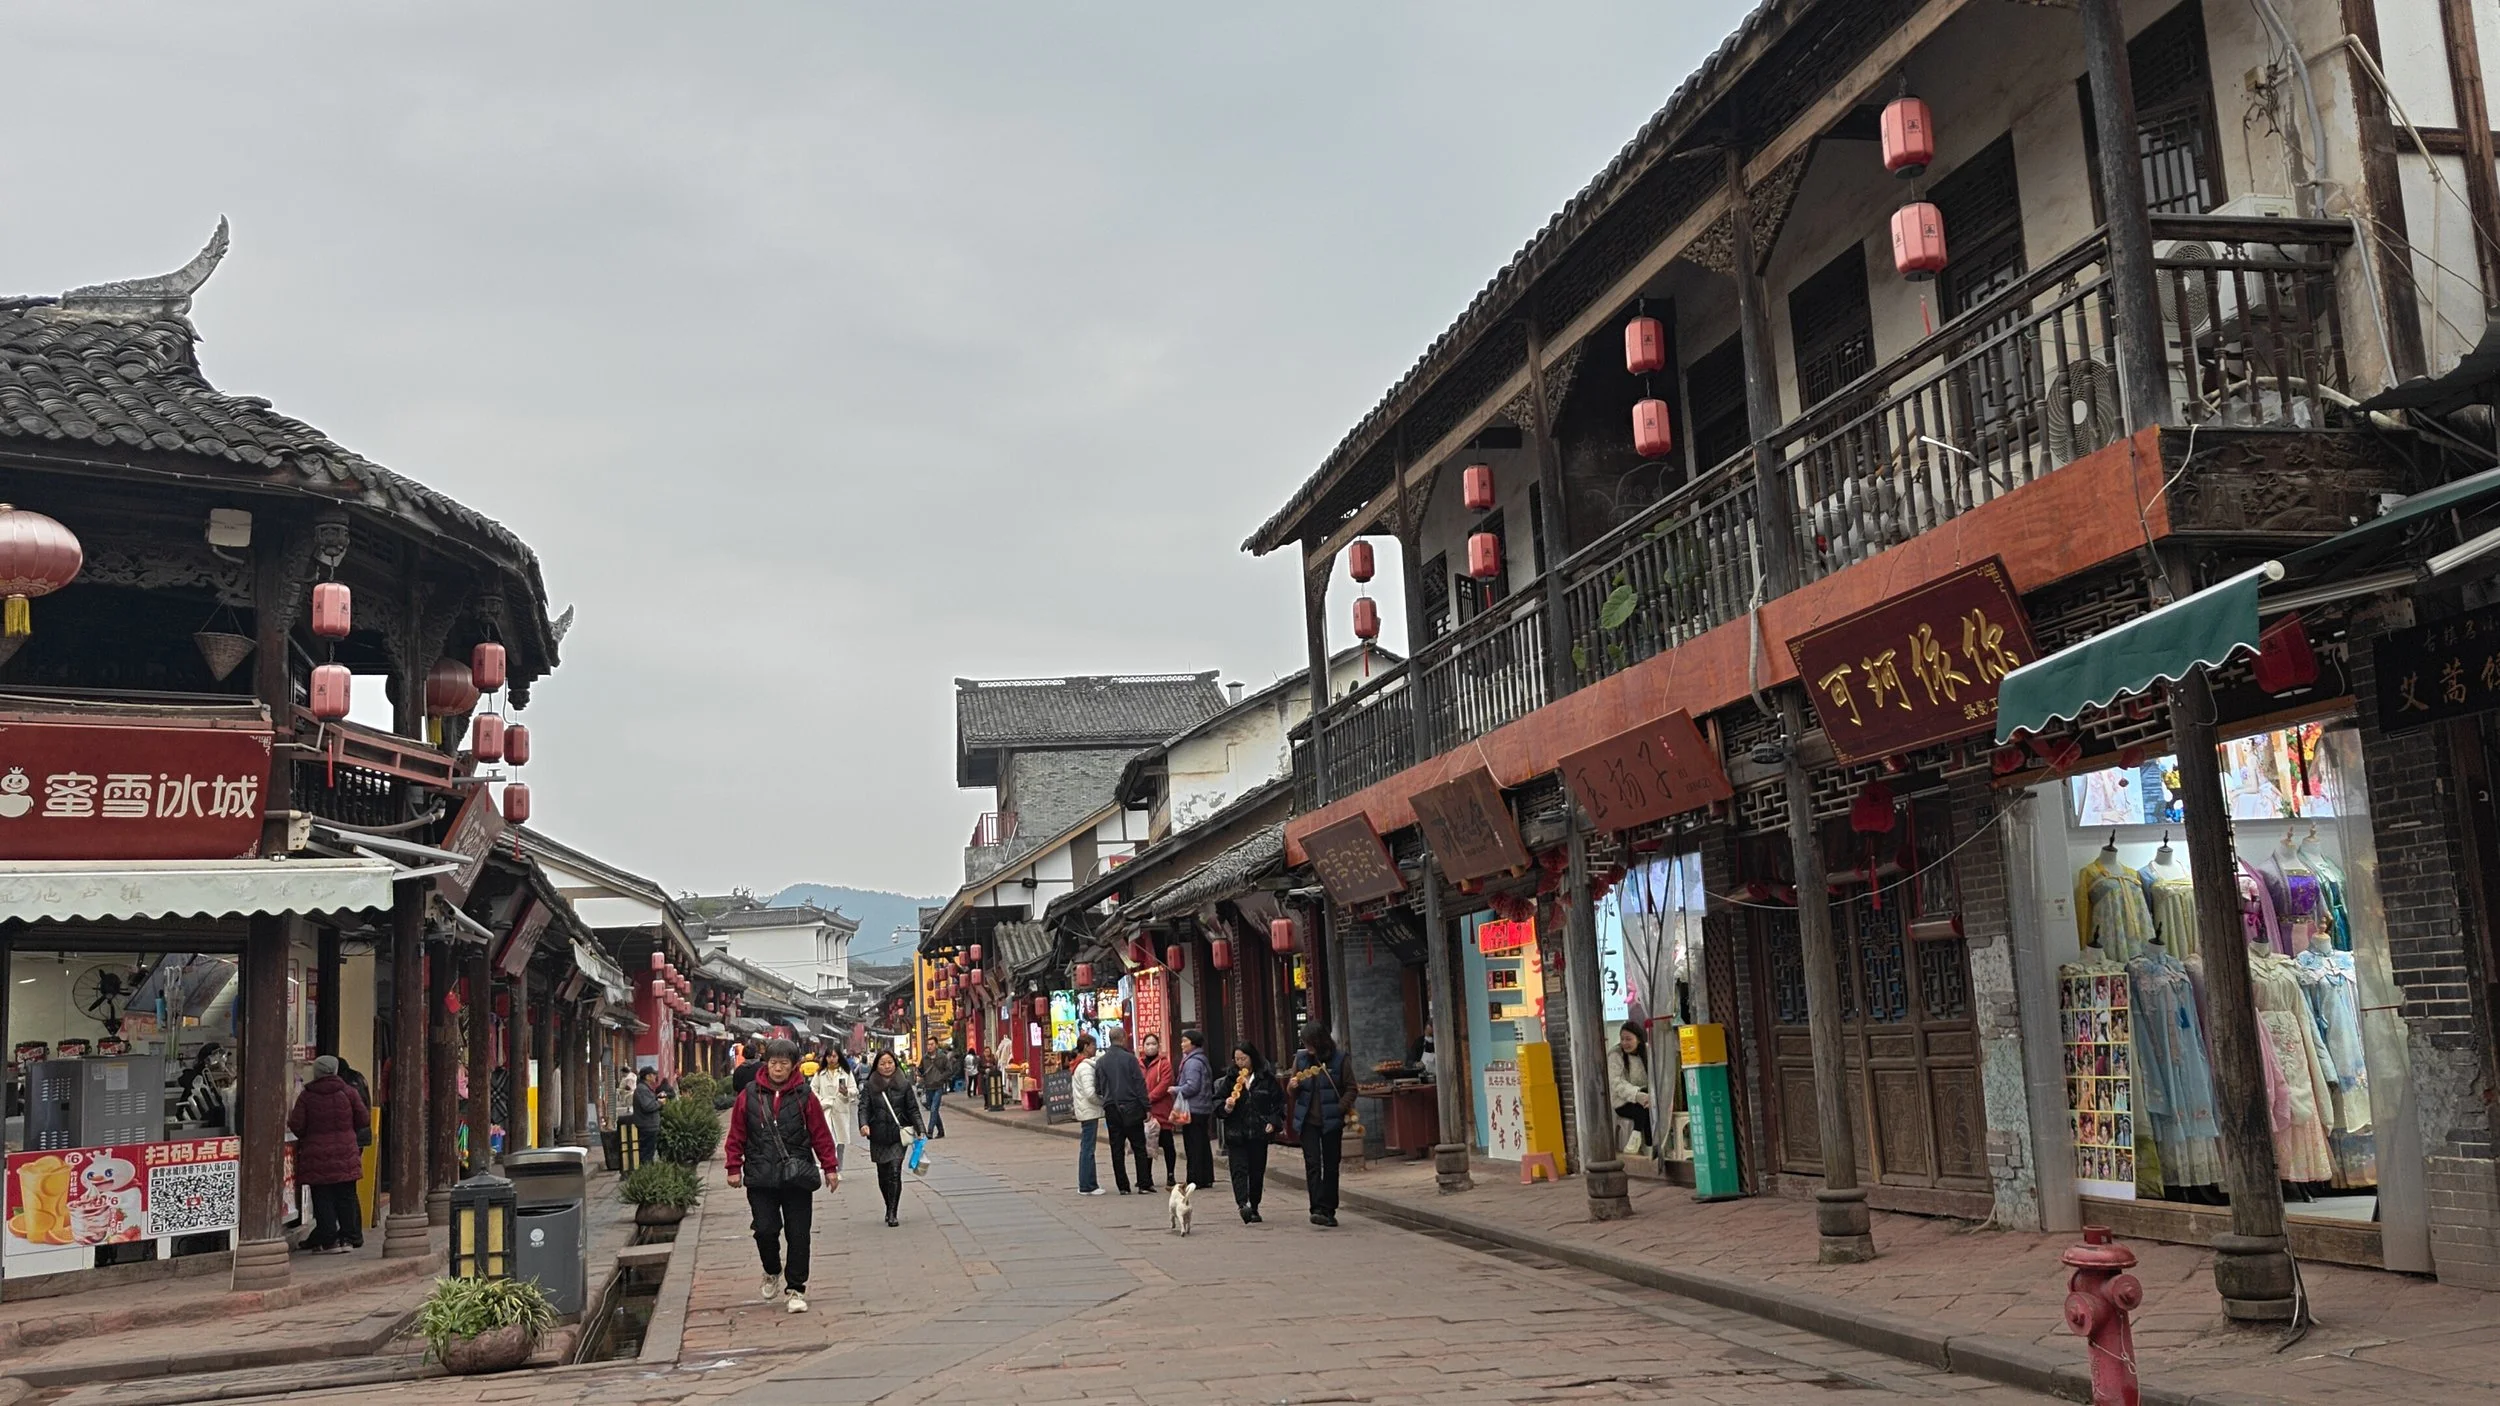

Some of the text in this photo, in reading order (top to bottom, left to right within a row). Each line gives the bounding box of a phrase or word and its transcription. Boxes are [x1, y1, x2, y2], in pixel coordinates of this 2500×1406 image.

[42, 771, 258, 818] 蜜雪冰城
[145, 1139, 240, 1166] 扫码点单
